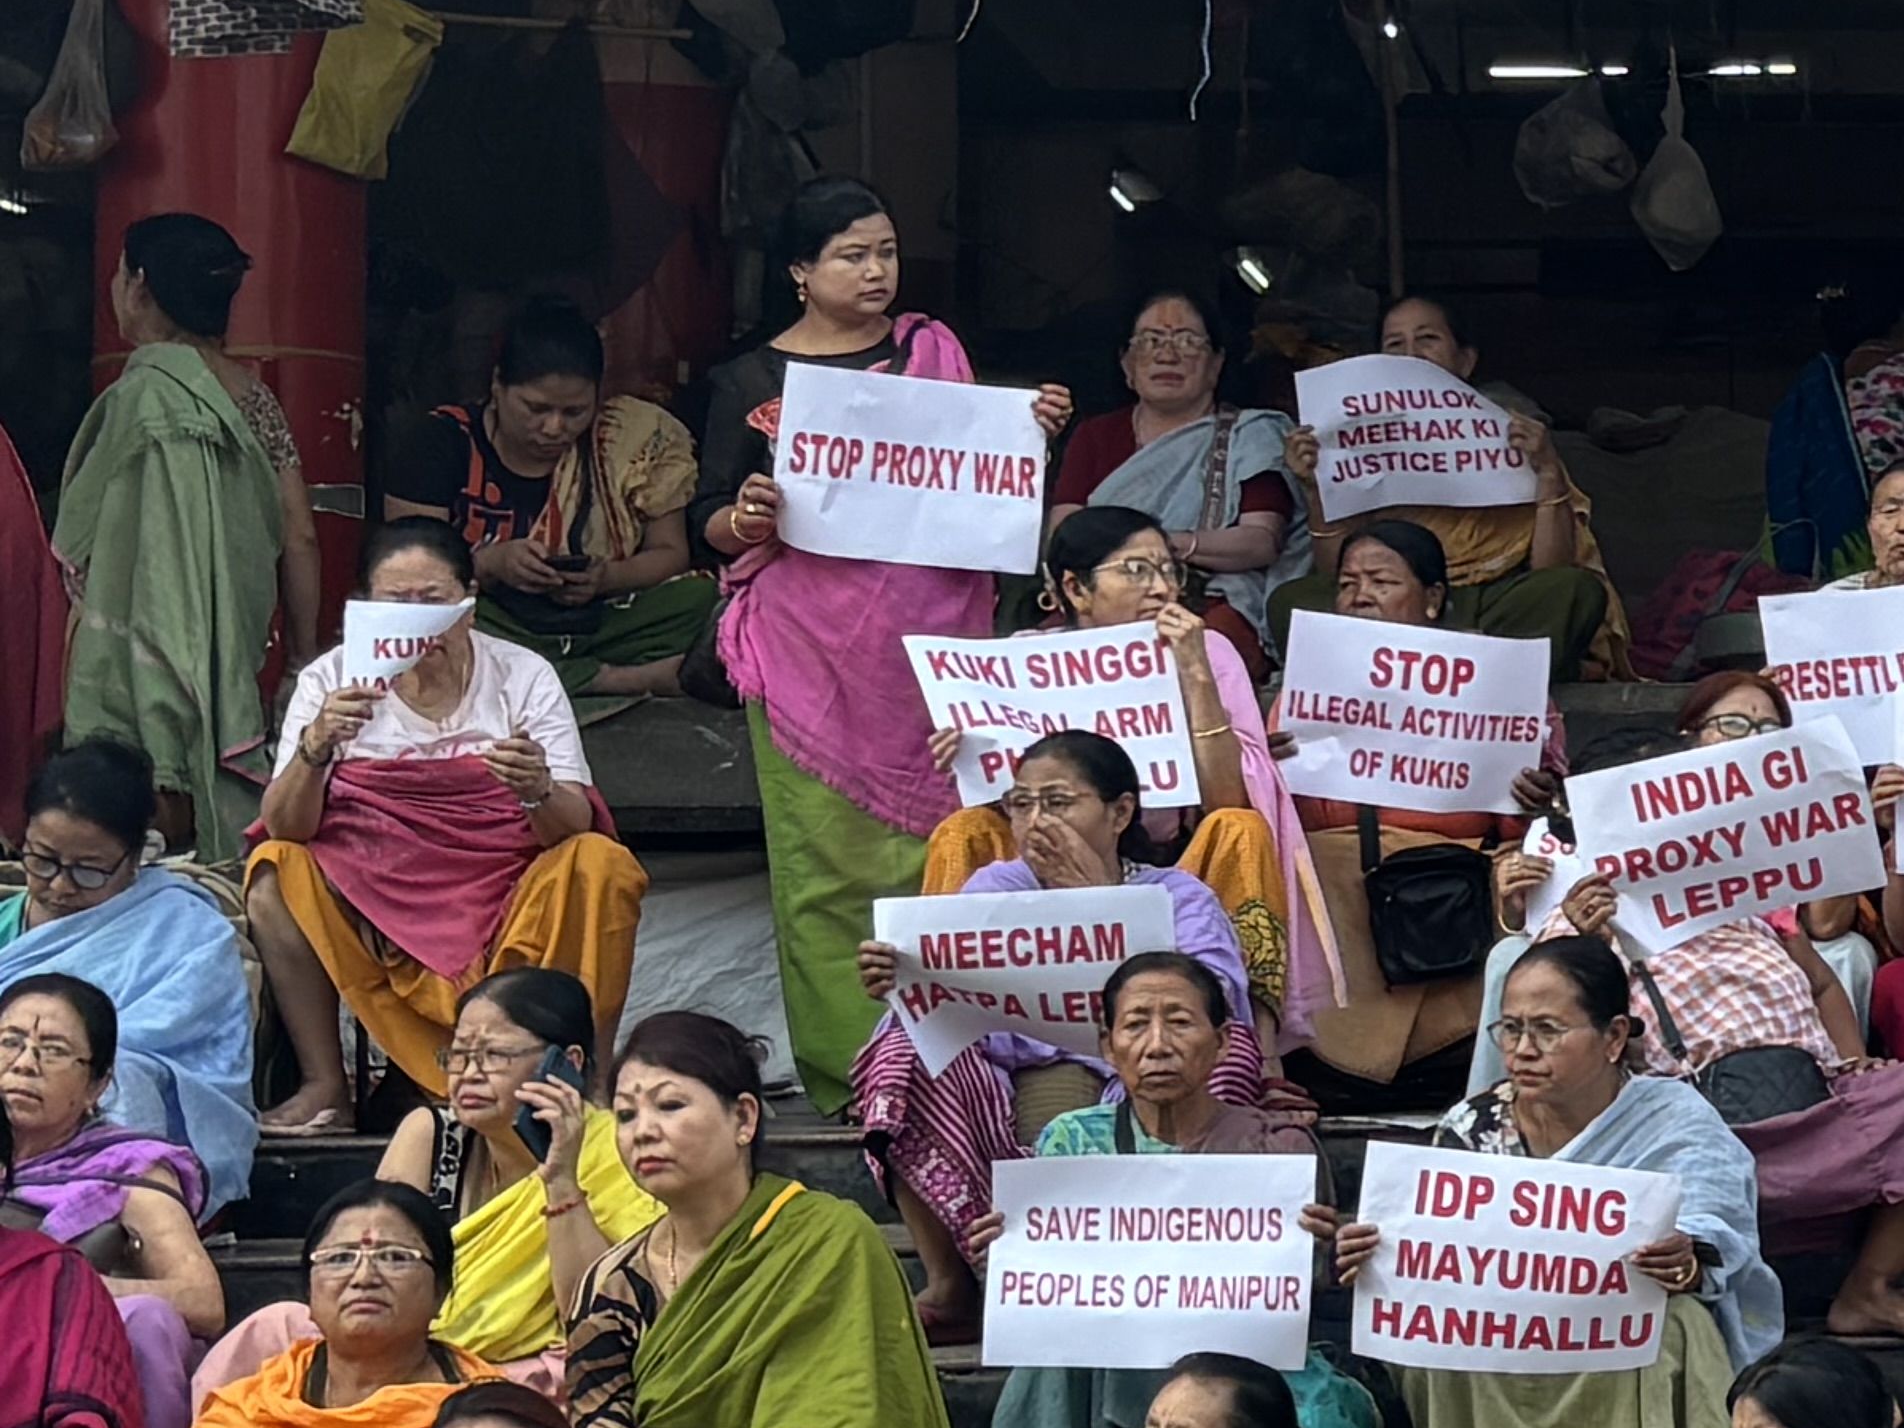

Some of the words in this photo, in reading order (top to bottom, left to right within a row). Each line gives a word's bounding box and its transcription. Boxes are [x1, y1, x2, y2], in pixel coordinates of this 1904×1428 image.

[1343, 389, 1484, 418] SUNULOK
[1337, 418, 1466, 449] MEEHAK
[1473, 419, 1500, 438] KI
[789, 431, 864, 480] STOP
[870, 441, 966, 491] PROXY
[974, 452, 1037, 498] WAR
[1331, 450, 1449, 484] JUSTICE
[1455, 447, 1525, 473] PIYU
[925, 649, 1017, 690] KUKI
[1026, 638, 1171, 690] SINGGI
[1370, 647, 1475, 697] STOP
[1095, 702, 1174, 739] ARM
[1288, 690, 1393, 731] ILLEGAL
[1400, 706, 1539, 743] ACTIVITIES
[1349, 749, 1384, 779] OF
[1390, 755, 1471, 790] KUKIS
[1631, 762, 1754, 824] INDIA
[1762, 745, 1808, 791] GI
[1594, 821, 1747, 885] PROXY
[1761, 792, 1867, 848] WAR
[1652, 856, 1825, 930] LEPPU
[919, 922, 1127, 971] MEECHAM
[1026, 1206, 1100, 1243] SAVE
[1109, 1206, 1283, 1242] INDIGENOUS
[1414, 1169, 1495, 1221] IDP
[1509, 1180, 1627, 1236] SING
[1000, 1270, 1125, 1307] PEOPLES
[1133, 1274, 1170, 1308] OF
[1177, 1275, 1300, 1312] MANIPUR
[1395, 1239, 1629, 1296] MAYUMDA
[1371, 1297, 1654, 1352] HANHALLU
